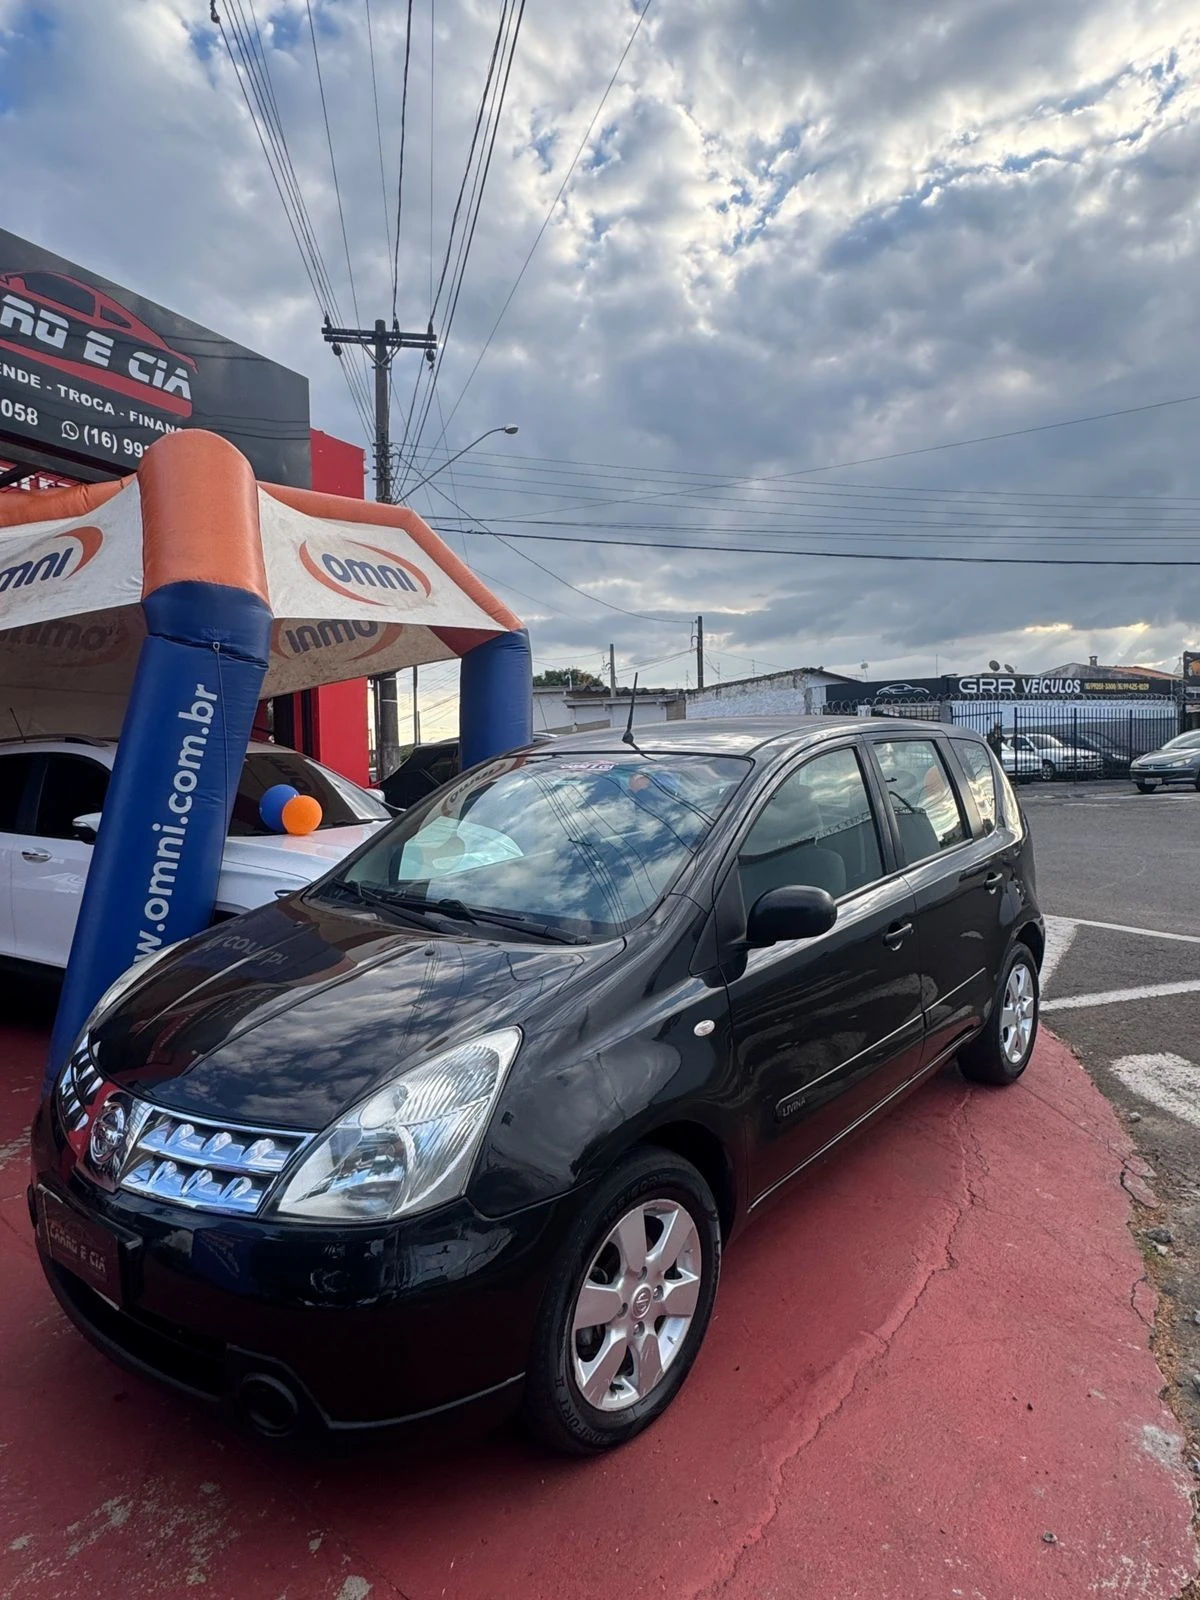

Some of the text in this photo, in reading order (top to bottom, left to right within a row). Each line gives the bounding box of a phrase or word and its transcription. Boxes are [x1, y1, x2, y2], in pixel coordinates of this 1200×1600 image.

[83, 330, 114, 367] E
[0, 361, 41, 389] NDE
[57, 384, 115, 416] TROCA
[129, 410, 183, 434] FINAN
[1, 398, 150, 458] 058 (16) 99
[321, 553, 418, 592] omni
[958, 678, 1016, 694] GRR
[1021, 677, 1081, 694] VEÍCULOS
